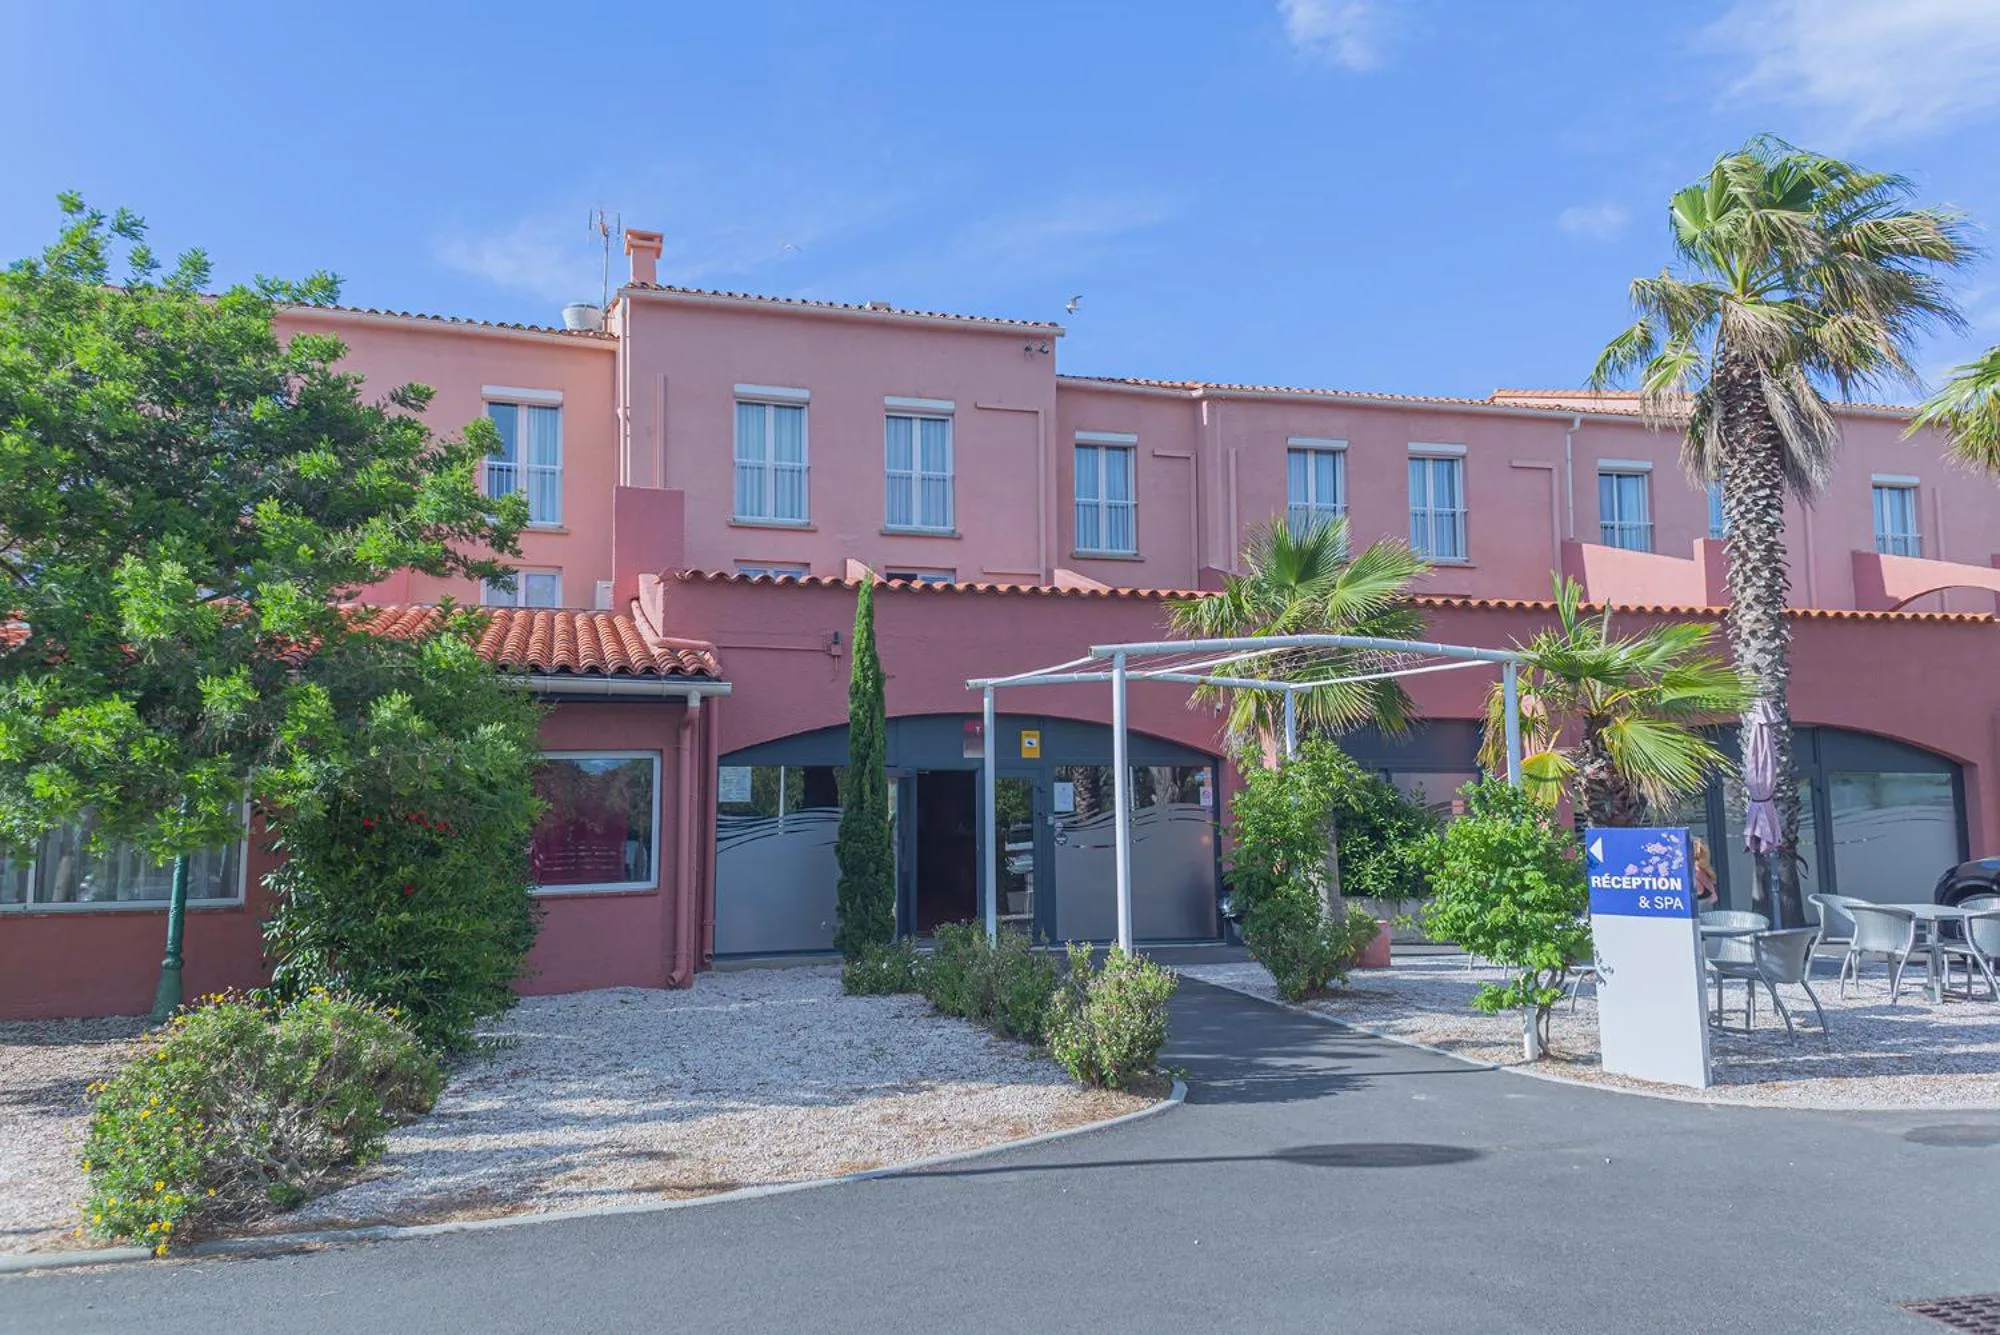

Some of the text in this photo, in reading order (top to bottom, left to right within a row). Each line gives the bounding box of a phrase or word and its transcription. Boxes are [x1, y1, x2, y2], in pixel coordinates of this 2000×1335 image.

[1591, 873, 1682, 891] RÉCEPTION
[1639, 896, 1684, 910] & SPA
